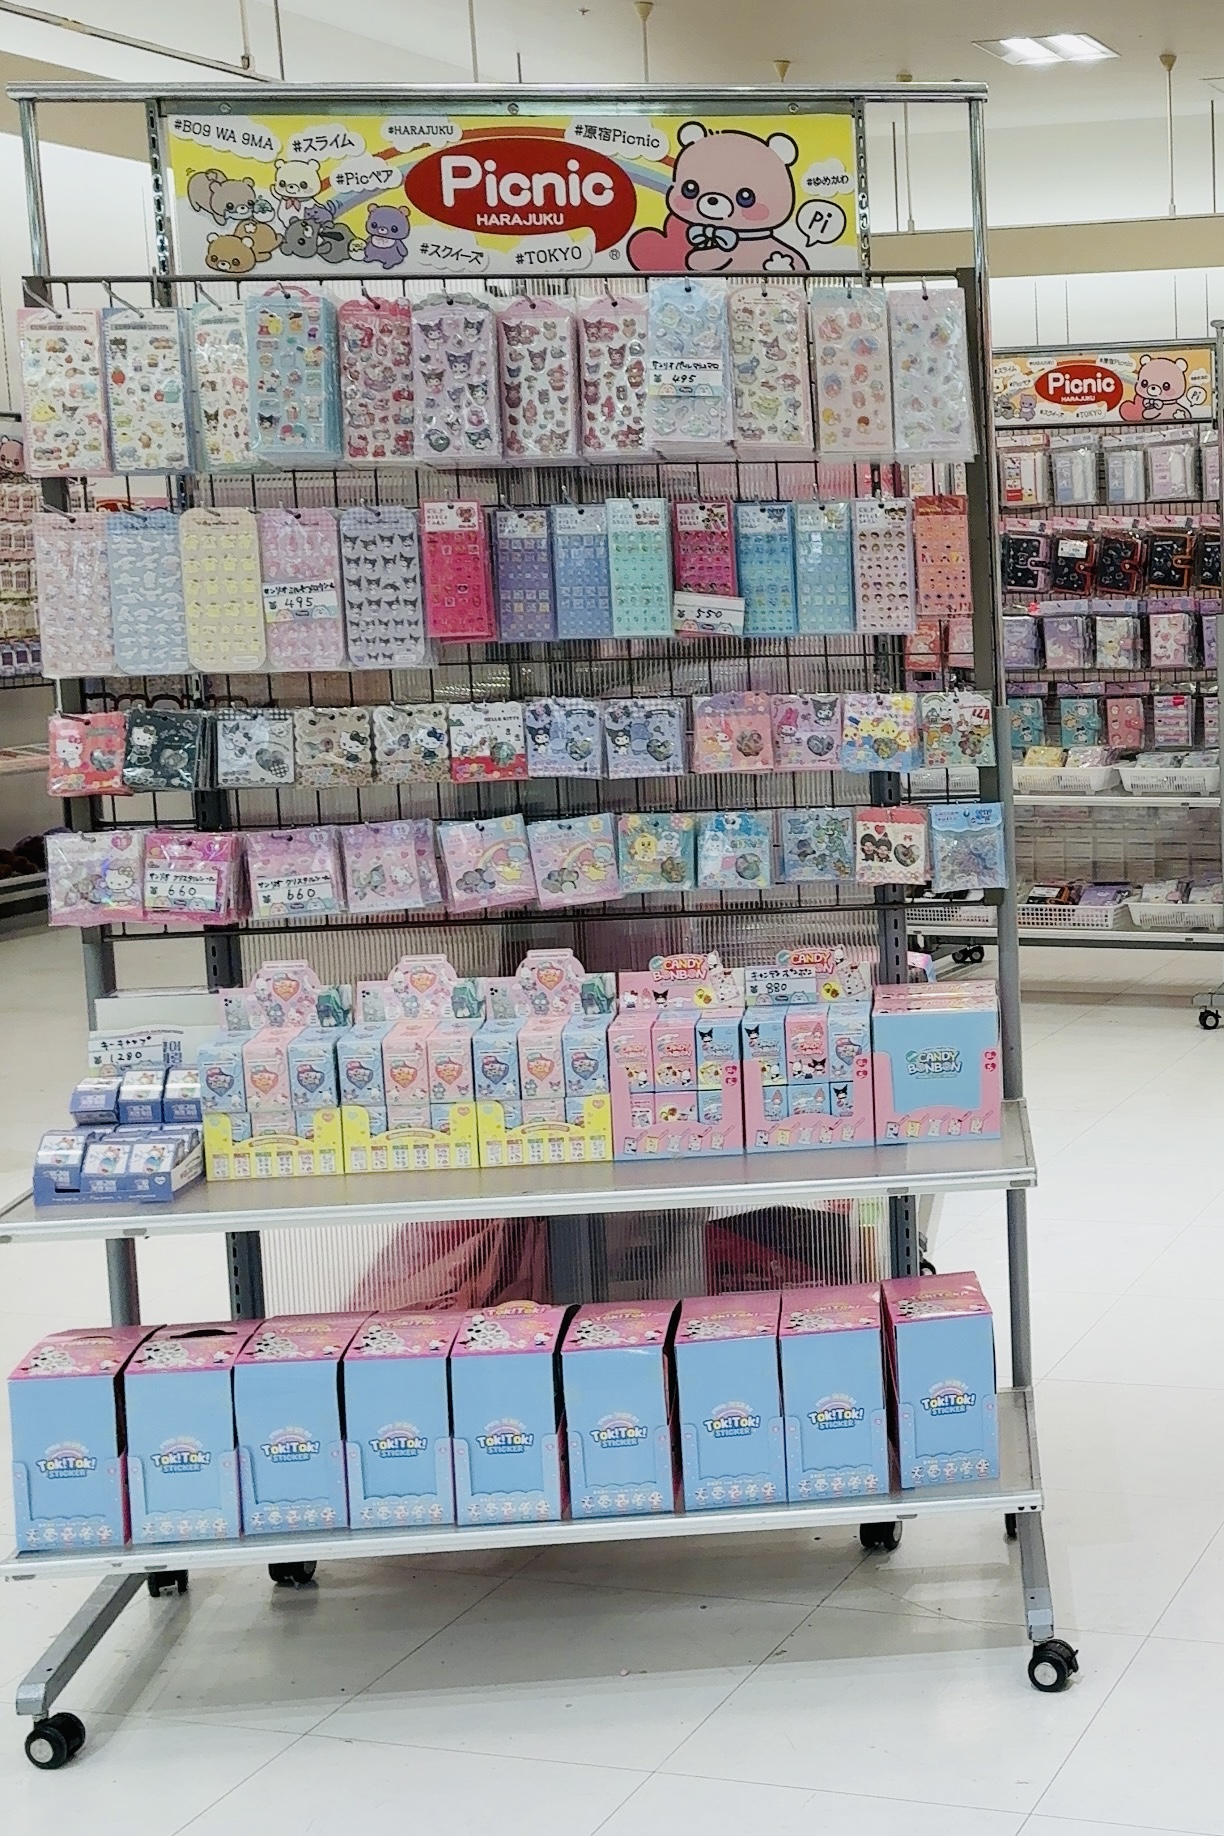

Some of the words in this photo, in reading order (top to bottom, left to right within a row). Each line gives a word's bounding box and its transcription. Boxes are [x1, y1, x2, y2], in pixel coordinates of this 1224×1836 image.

[388, 125, 454, 136] #HARAJUKU
[574, 124, 661, 149] #原宿Picnic
[215, 128, 237, 144] WA
[242, 132, 274, 151] 9MA
[292, 133, 355, 154] #スライム
[336, 169, 394, 187] #Picベア
[440, 155, 615, 208] Picnic
[806, 174, 849, 187] #ゆめかわ
[476, 213, 564, 226] HARAJUKU
[809, 212, 832, 234] Pi
[419, 242, 485, 265] #スクイーズ
[515, 246, 582, 265] #TOKYO
[672, 374, 697, 383] 495
[1048, 372, 1116, 396] Picnic
[1191, 392, 1202, 401] Pi
[1076, 409, 1103, 418] #TOKYO
[284, 596, 314, 608] 495
[696, 608, 722, 620] 550
[167, 886, 197, 896] 660
[286, 888, 316, 900] 660
[663, 958, 705, 970] CANDY
[791, 952, 833, 966] CANDY
[653, 970, 707, 982] BONBON
[765, 982, 788, 993] 880
[110, 1052, 142, 1063] 1280
[919, 1050, 960, 1062] CANDY
[907, 1061, 962, 1075] BONBON
[921, 1394, 976, 1411] Tok!Tok!
[807, 1408, 864, 1424] Tok!Tok!
[930, 1406, 967, 1416] STICKER
[703, 1416, 761, 1432] Tok!Tok!
[818, 1420, 855, 1430] STICKER
[590, 1426, 648, 1442] Tok!Tok!
[714, 1428, 752, 1438] STICKER
[369, 1437, 428, 1452] Tok!Tok!
[476, 1433, 534, 1448] Tok!Tok!
[602, 1438, 638, 1448] STICKER
[260, 1442, 320, 1456] Tok!Tok!
[379, 1449, 418, 1458] STICKER
[487, 1445, 525, 1455] STICKER
[152, 1452, 211, 1469] Tok!Tok!
[272, 1453, 311, 1463] STICKER
[36, 1457, 97, 1472] Tok!Tok!
[162, 1465, 202, 1473] STICKER
[49, 1470, 87, 1479] STICKER
